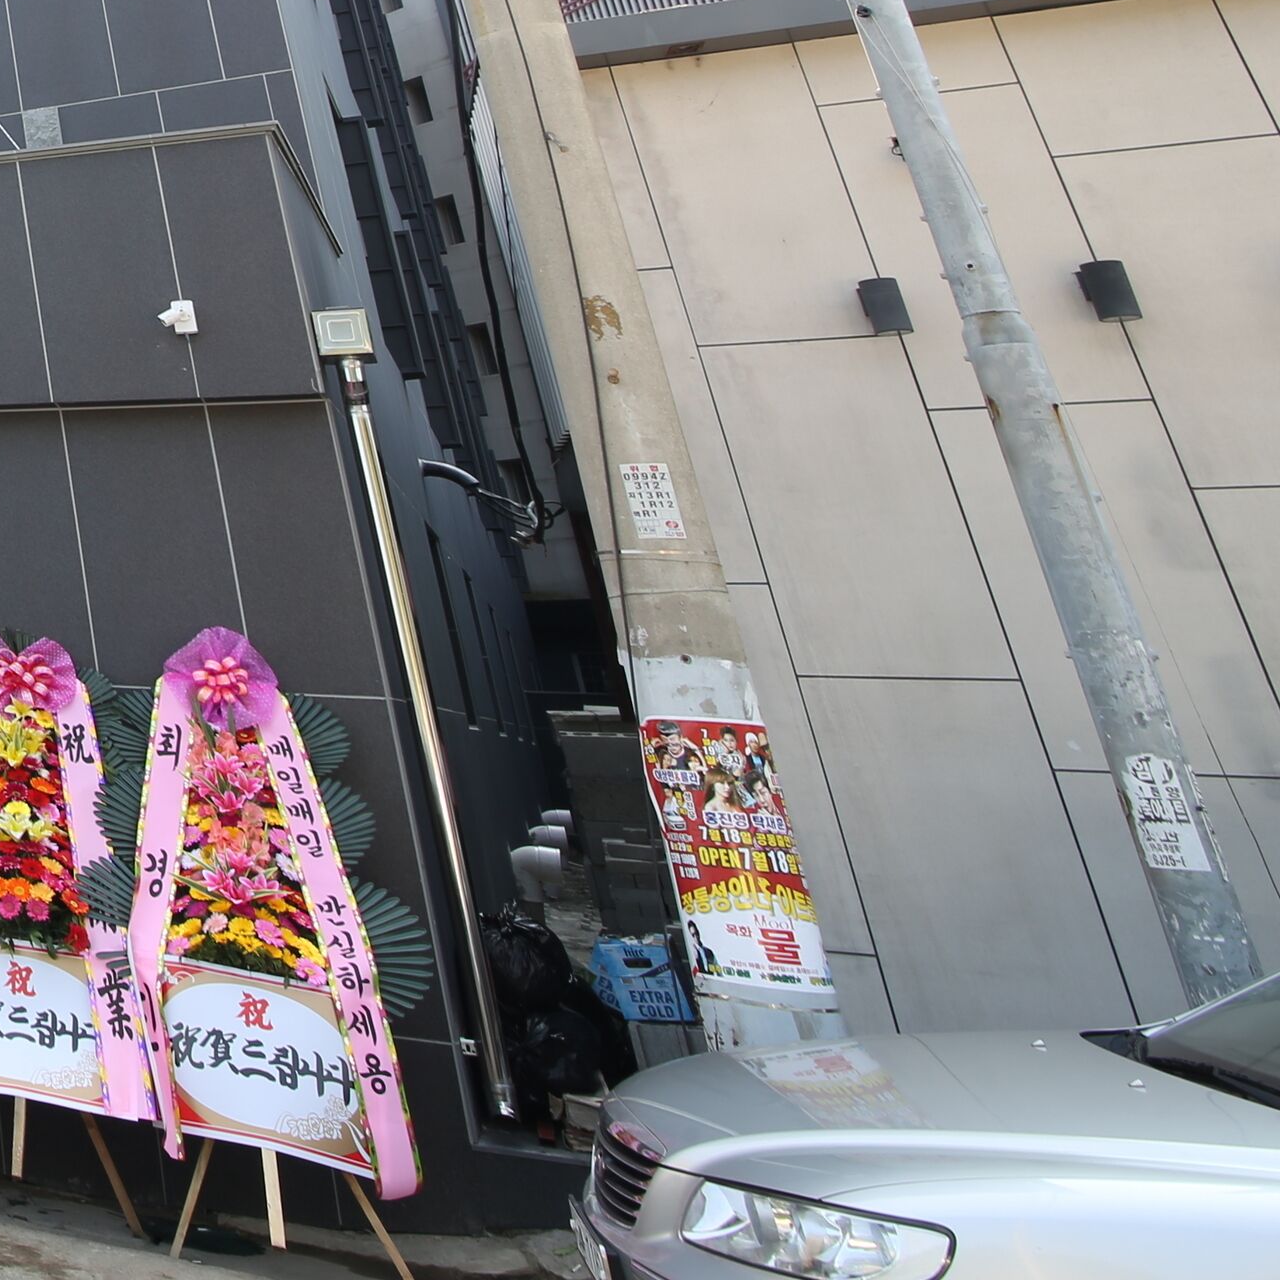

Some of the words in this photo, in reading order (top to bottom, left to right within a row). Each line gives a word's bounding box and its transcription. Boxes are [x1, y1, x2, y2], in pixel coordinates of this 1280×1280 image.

[634, 481, 660, 490] 312
[267, 735, 325, 859] 매일매일
[757, 927, 802, 966] 물
[3, 960, 37, 997] 祝
[628, 989, 675, 1004] EXTRA
[237, 991, 273, 1031] 祝
[638, 1004, 675, 1019] COLD
